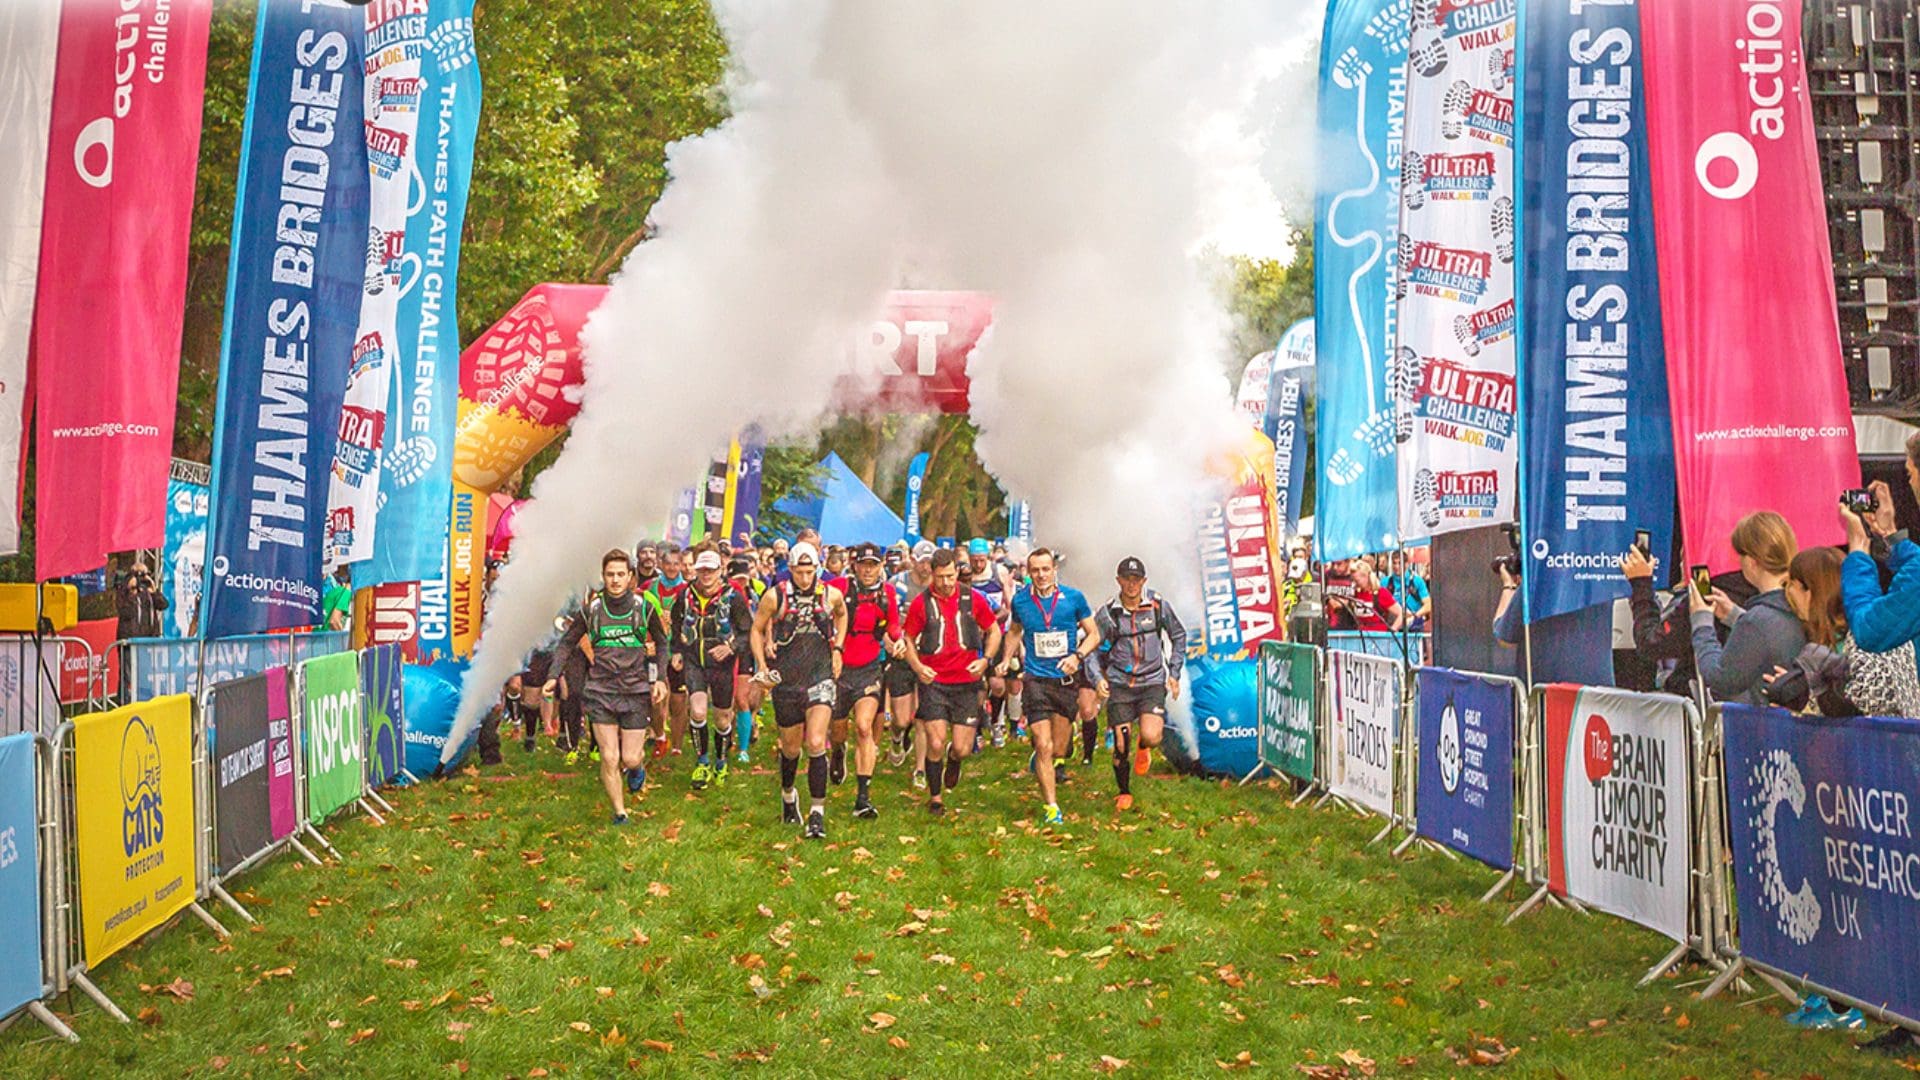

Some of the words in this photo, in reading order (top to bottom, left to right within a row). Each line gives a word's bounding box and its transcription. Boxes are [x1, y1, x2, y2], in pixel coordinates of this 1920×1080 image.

[272, 29, 347, 288] BRIDGES
[434, 81, 457, 194] THAMES
[1565, 26, 1633, 271] BRIDGES
[1430, 158, 1489, 176] ULTRA
[1430, 176, 1489, 190] CHALLENGE
[426, 200, 448, 268] PATH
[1416, 269, 1482, 294] CHALLENGE
[1419, 247, 1485, 279] ULTRA
[411, 272, 443, 433] CHALLENGE
[1426, 395, 1511, 432] CHALLENGE
[1430, 366, 1516, 414] ULTRA
[1564, 284, 1629, 531] THAMES
[248, 298, 310, 551] THAMES
[1441, 475, 1496, 494] ULTRA
[1442, 494, 1496, 507] CHALLENGE
[1226, 494, 1276, 643] ULTRA
[1344, 653, 1372, 704] HELP
[310, 687, 360, 779] NSPCC
[1218, 726, 1257, 739] action
[1346, 706, 1388, 771] HEROES
[1590, 730, 1608, 762] The
[1611, 733, 1667, 787] BRAIN
[123, 795, 164, 858] CATS
[1592, 777, 1668, 839] TUMOUR
[1815, 781, 1912, 839] CANCER
[125, 849, 164, 882] PROTECTION
[1591, 825, 1669, 888] CHARITY
[1831, 891, 1863, 941] UK
